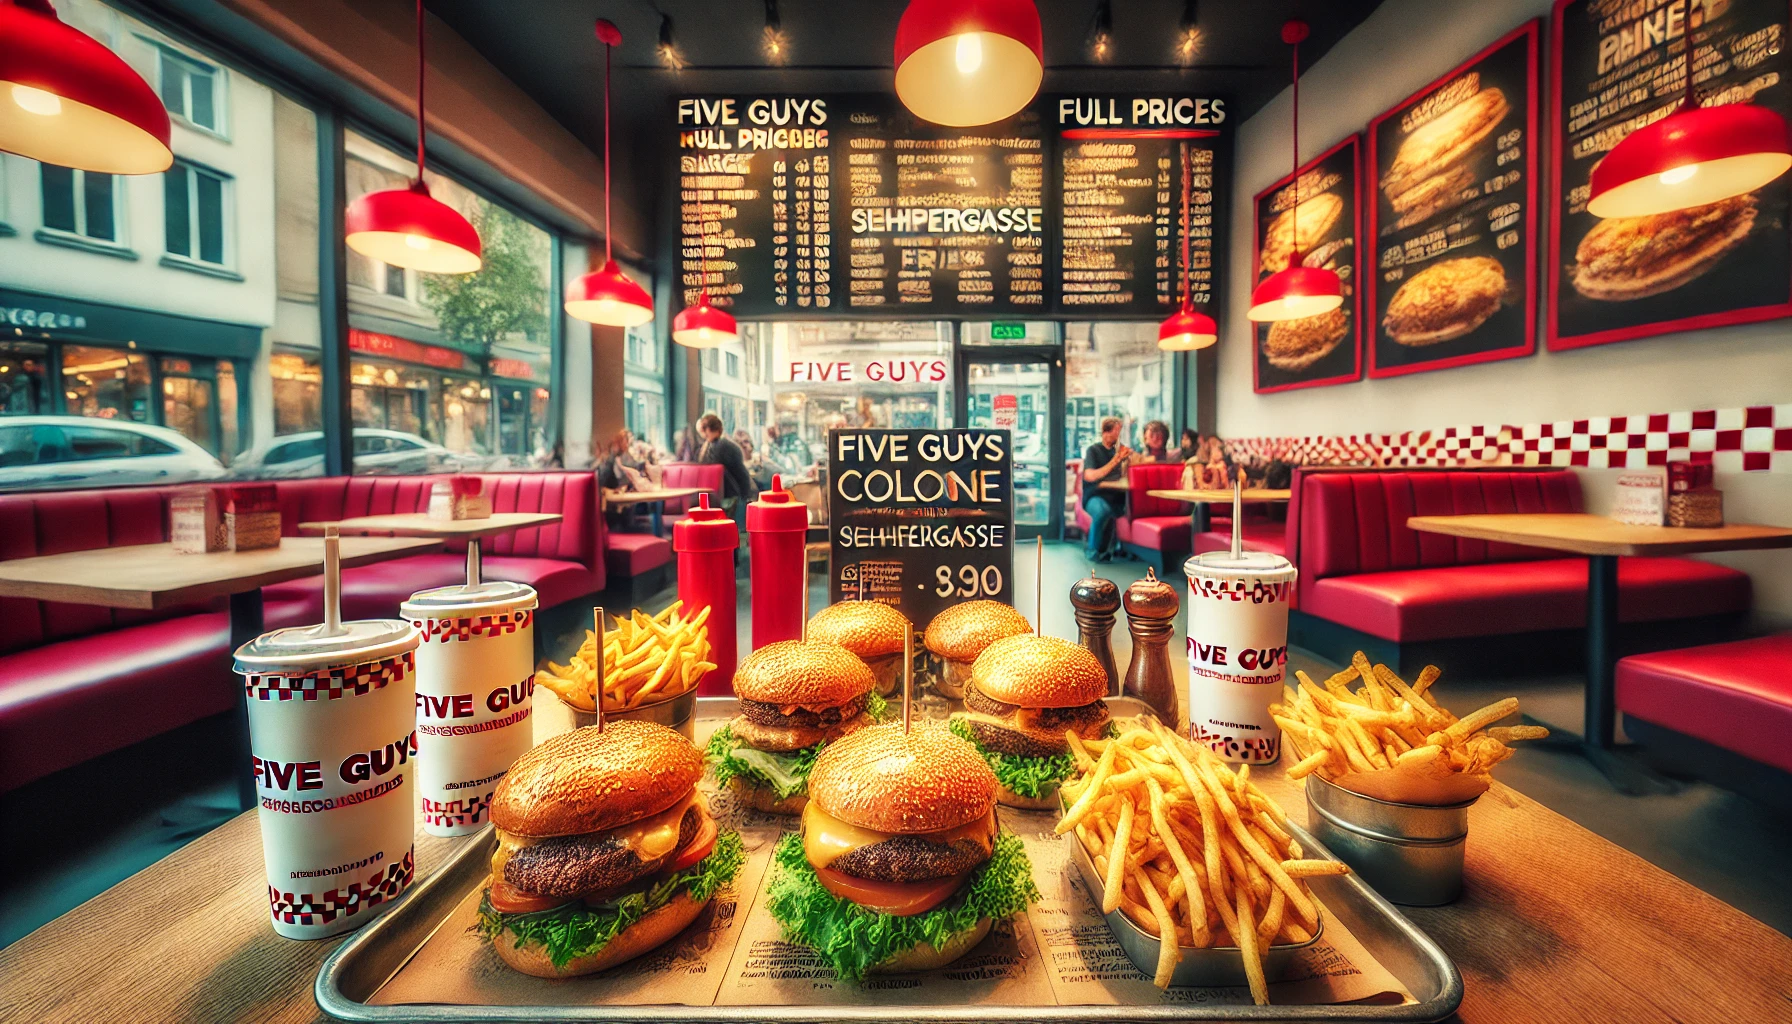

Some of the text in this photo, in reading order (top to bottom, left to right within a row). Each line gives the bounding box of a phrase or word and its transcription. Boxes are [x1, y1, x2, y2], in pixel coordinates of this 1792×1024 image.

[678, 98, 740, 126] FIVE
[748, 98, 828, 126] GUYS
[1059, 98, 1226, 125] FULL PRICES
[790, 360, 946, 382] FIVE GUYS
[838, 433, 1005, 462] FIVE GUYS
